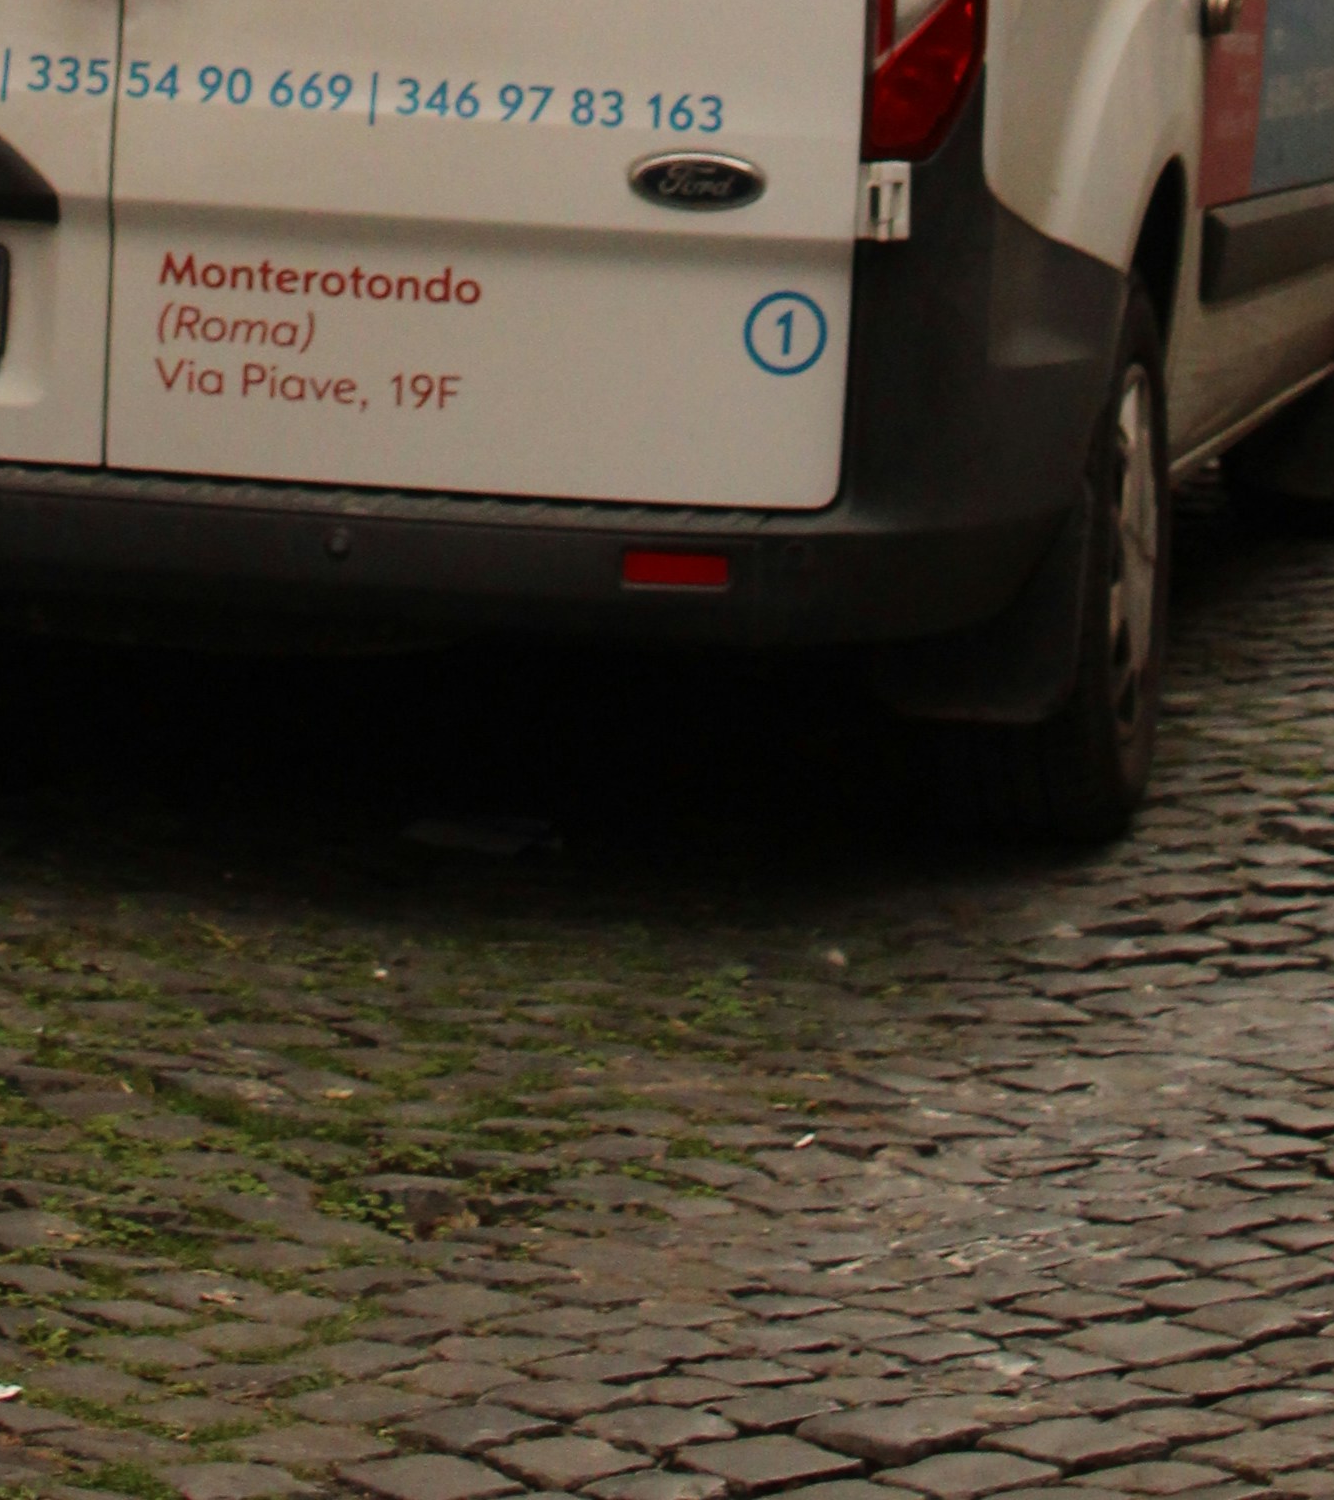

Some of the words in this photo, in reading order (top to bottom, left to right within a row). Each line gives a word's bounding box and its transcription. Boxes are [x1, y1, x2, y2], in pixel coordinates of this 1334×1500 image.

[27, 54, 111, 95] 335
[125, 60, 180, 100] 54
[198, 65, 253, 105] 90
[269, 69, 354, 112] 669
[395, 77, 482, 120] 346
[498, 83, 556, 123] 97
[570, 88, 626, 129] 83
[647, 92, 724, 133] 163
[658, 162, 737, 197] Ford
[159, 251, 482, 305] Monterotondo
[157, 301, 316, 354] (Roma)
[776, 309, 795, 357] 1
[154, 356, 225, 396] Via
[240, 362, 369, 413] Piave,
[390, 372, 463, 410] 19F
